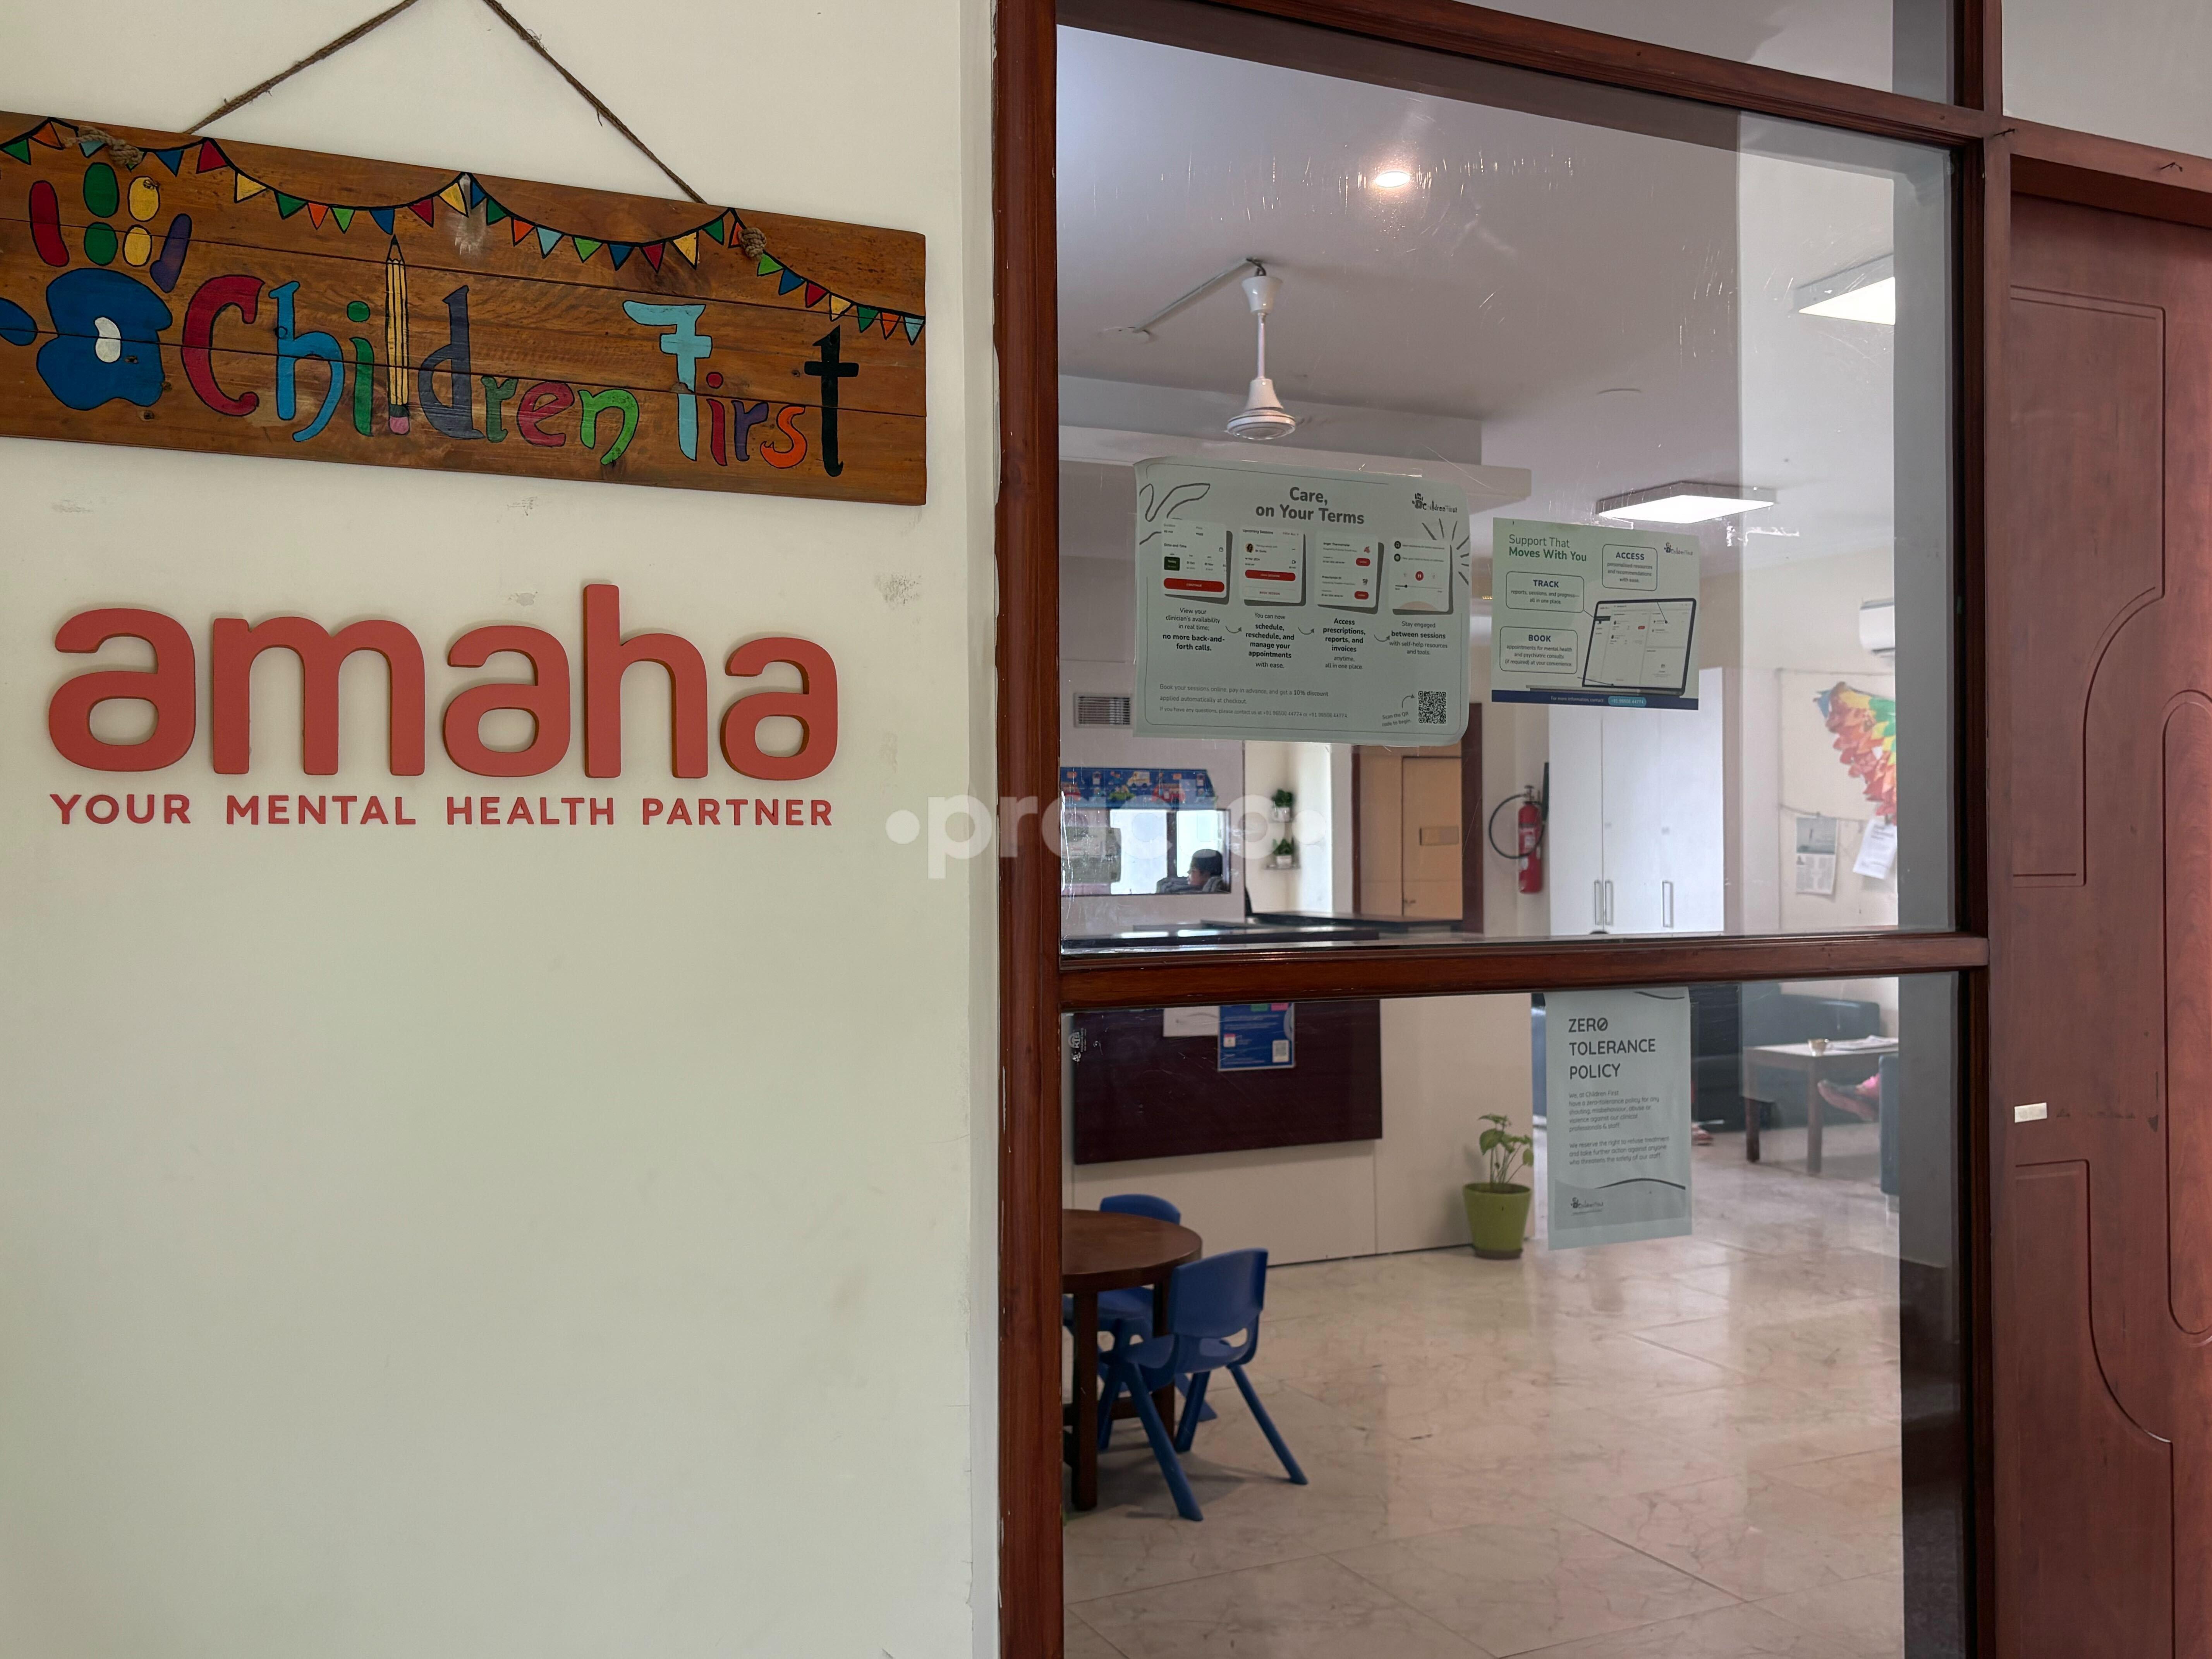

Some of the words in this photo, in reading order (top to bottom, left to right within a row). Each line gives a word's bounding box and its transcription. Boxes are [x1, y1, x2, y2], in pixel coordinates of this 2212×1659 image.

[182, 234, 640, 466] Children
[622, 299, 860, 477] First
[1290, 487, 1328, 505] Care,
[1256, 506, 1274, 517] on
[1279, 504, 1314, 520] Your
[1318, 508, 1364, 524] Terms
[1509, 534, 1547, 547] Support
[1549, 537, 1570, 548] That
[1509, 546, 1540, 558] Moves
[1543, 549, 1567, 560] With
[1570, 551, 1587, 561] You
[1616, 552, 1645, 560] ACCESS
[1533, 580, 1559, 588] TRACK
[1255, 623, 1285, 631] schedule,
[1245, 632, 1281, 640] reschedule,
[48, 584, 838, 780] amaha
[49, 793, 192, 826] YOUR
[226, 795, 416, 826] MENTAL
[447, 796, 615, 826] HEALTH
[642, 799, 833, 827] PARTNER
[1569, 1039, 1656, 1056] TOLERANCE
[1570, 1063, 1621, 1080] POLICY
